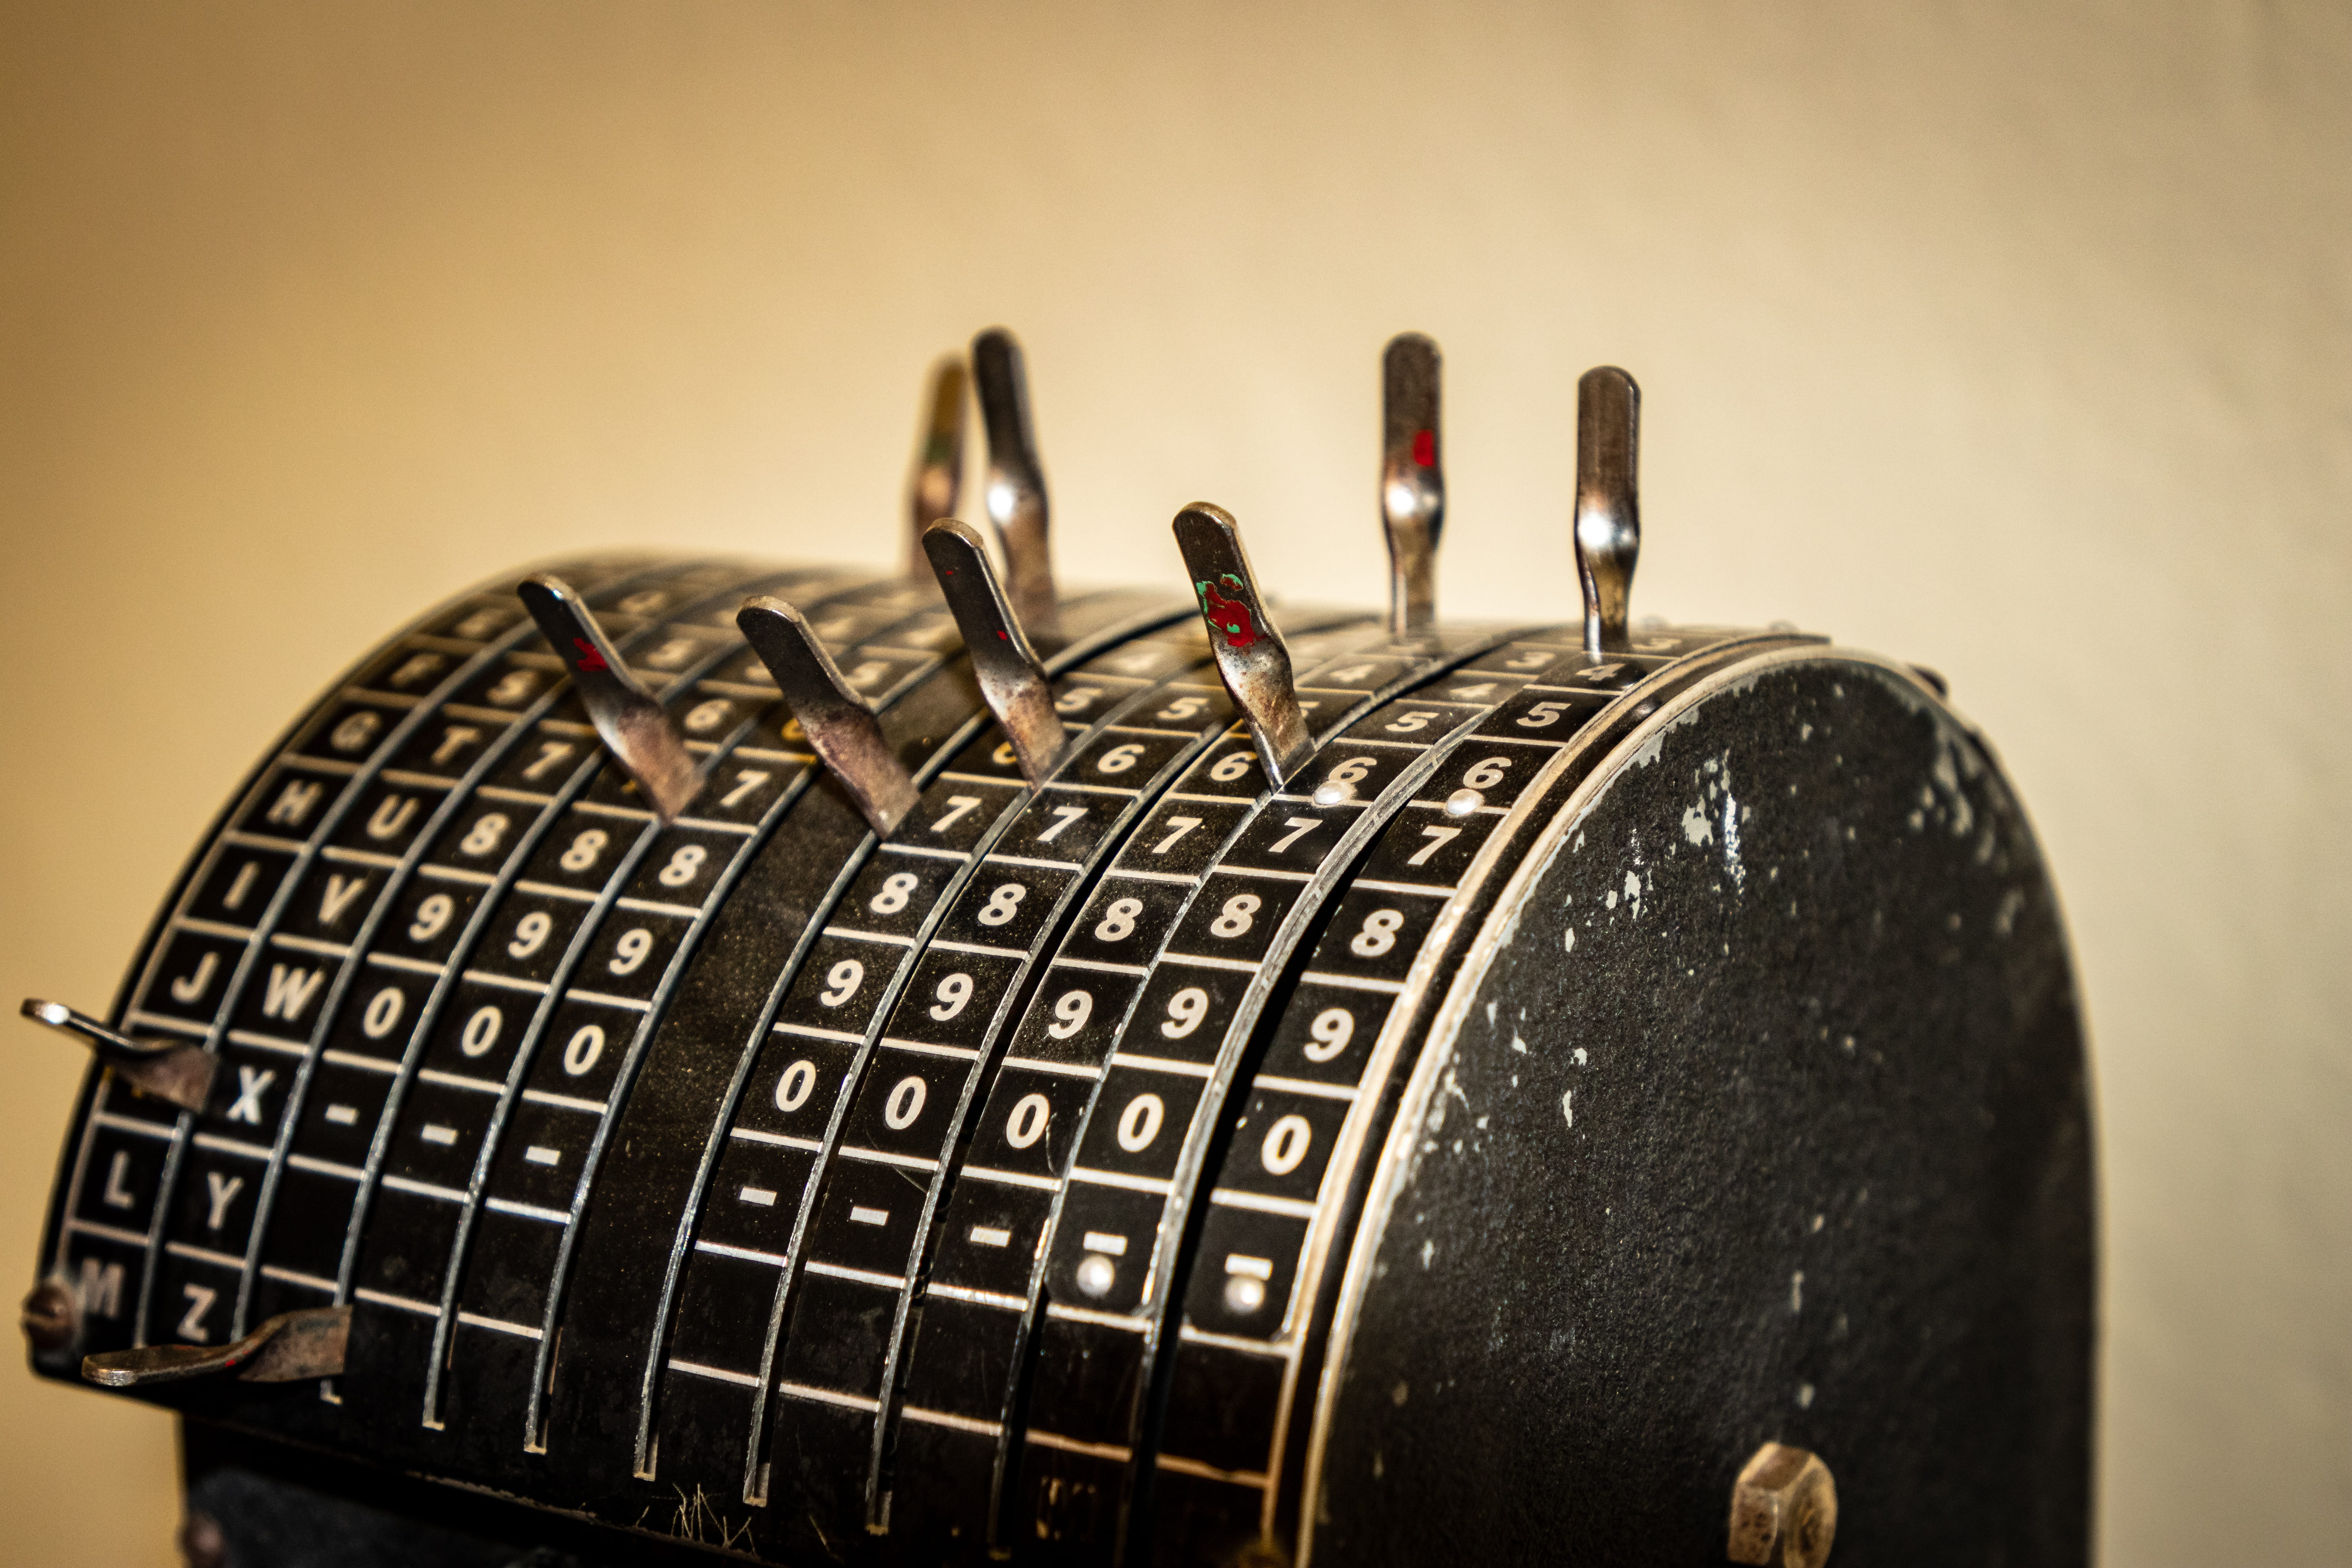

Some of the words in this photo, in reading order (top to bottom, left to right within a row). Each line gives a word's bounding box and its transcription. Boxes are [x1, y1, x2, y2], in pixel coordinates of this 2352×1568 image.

[1506, 652, 1555, 667] 3
[1575, 664, 1625, 681] 4
[1055, 688, 1102, 713] 5
[1158, 697, 1208, 719] 5
[1450, 684, 1496, 700] 4
[686, 700, 730, 730] 6
[1385, 712, 1439, 732] 5
[1516, 702, 1570, 727] 5
[434, 727, 478, 762] T
[524, 742, 572, 779] 7
[1098, 744, 1145, 773] 6
[721, 770, 769, 807] 7
[1210, 752, 1256, 782] 6
[1328, 757, 1377, 785] 6
[1457, 757, 1512, 794] 6
[269, 782, 319, 823] H
[367, 796, 416, 839] U
[931, 796, 981, 832] 7
[461, 814, 508, 855] 8
[1037, 806, 1087, 843] 7
[1152, 816, 1202, 853] 7
[1269, 817, 1322, 853] 7
[1408, 826, 1461, 866] 7
[561, 830, 607, 871] 8
[659, 845, 706, 886] 8
[319, 876, 364, 923] V
[870, 873, 918, 914] 8
[978, 884, 1026, 926] 8
[410, 895, 453, 940] 9
[508, 912, 551, 958] 9
[1095, 897, 1143, 941] 8
[1210, 894, 1261, 938] 8
[1351, 909, 1404, 956] 8
[609, 929, 652, 975] 9
[172, 953, 217, 1002] J
[264, 965, 323, 1020] W
[820, 960, 864, 1007] 9
[930, 973, 973, 1021] 9
[364, 988, 403, 1037] 0
[462, 1006, 501, 1056] 0
[1046, 991, 1092, 1040] 9
[1161, 988, 1208, 1038] 9
[564, 1025, 604, 1075] 0
[1304, 1008, 1354, 1062] 9
[228, 1067, 273, 1123] X
[775, 1060, 816, 1112] 0
[885, 1076, 926, 1129] 0
[1006, 1094, 1049, 1148] 0
[1118, 1094, 1163, 1152] 0
[1262, 1116, 1310, 1174] 0
[105, 1152, 132, 1207] L
[208, 1173, 241, 1229] Y
[80, 1258, 124, 1318] M
[180, 1285, 215, 1341] Z
